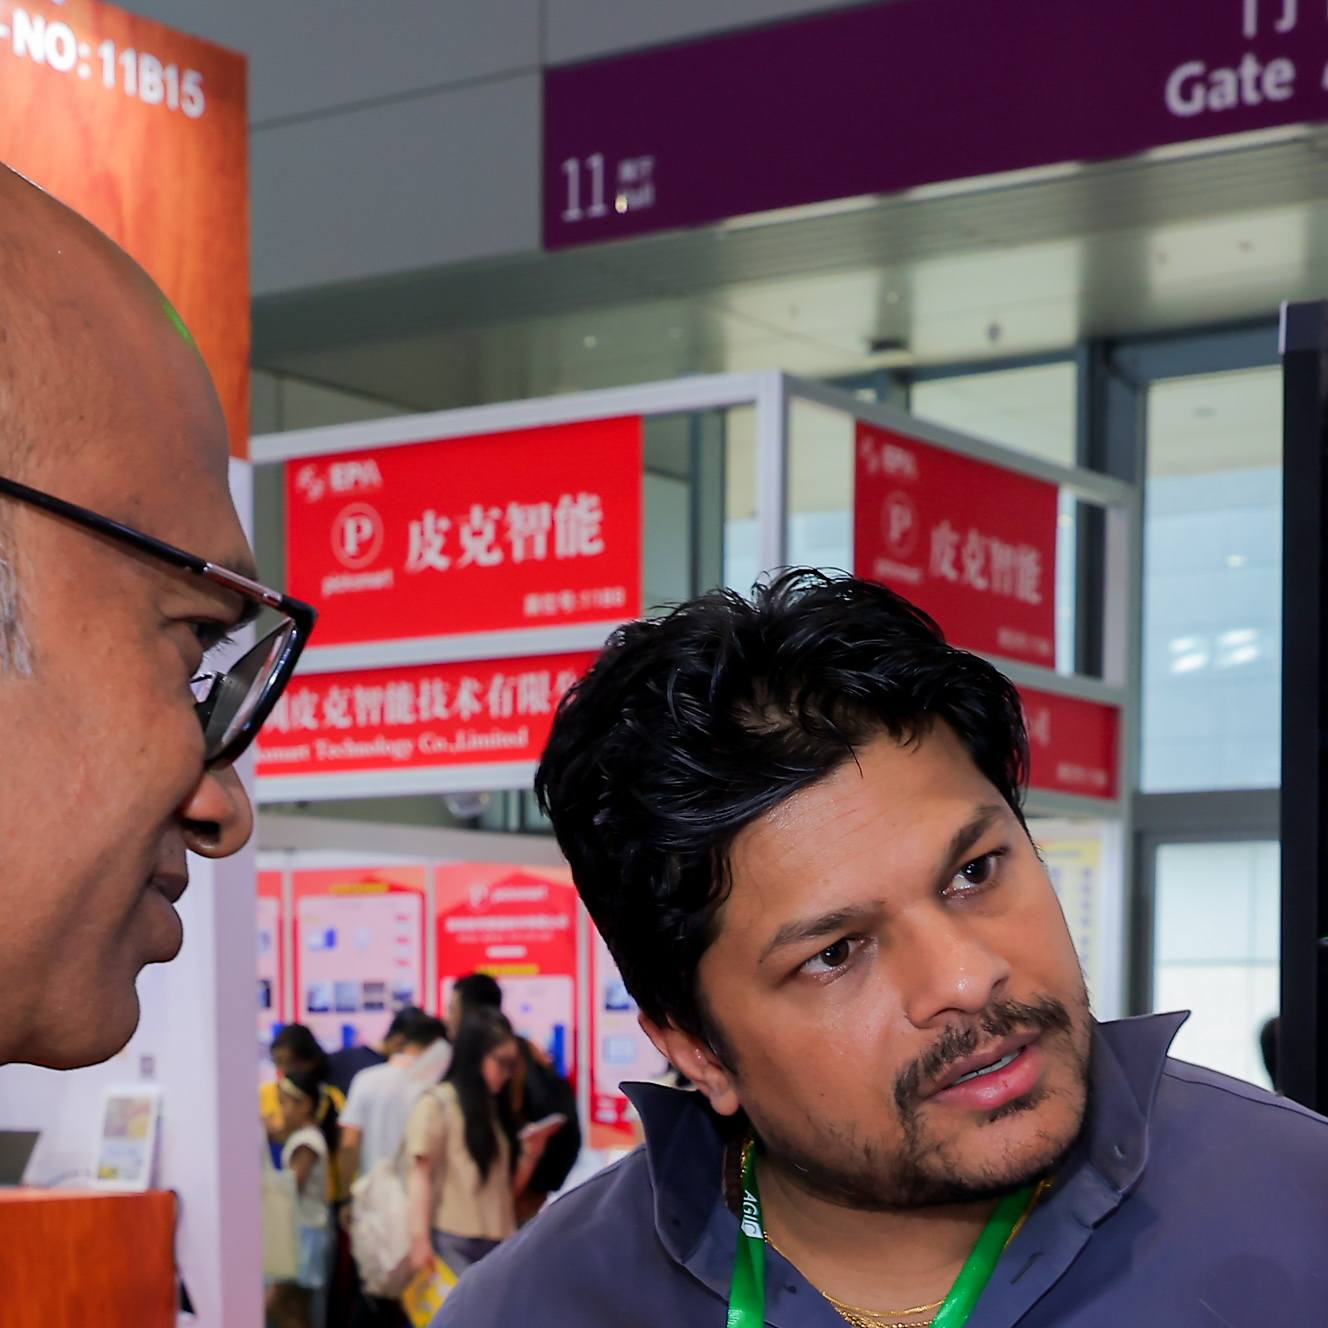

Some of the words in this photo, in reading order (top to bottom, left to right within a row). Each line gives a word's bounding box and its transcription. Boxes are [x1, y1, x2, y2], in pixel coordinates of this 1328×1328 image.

[1165, 53, 1296, 117] Gate
[561, 153, 608, 222] 11
[404, 491, 605, 574] 皮克智能
[928, 518, 1043, 606] 皮克智能
[315, 733, 414, 763] Technology
